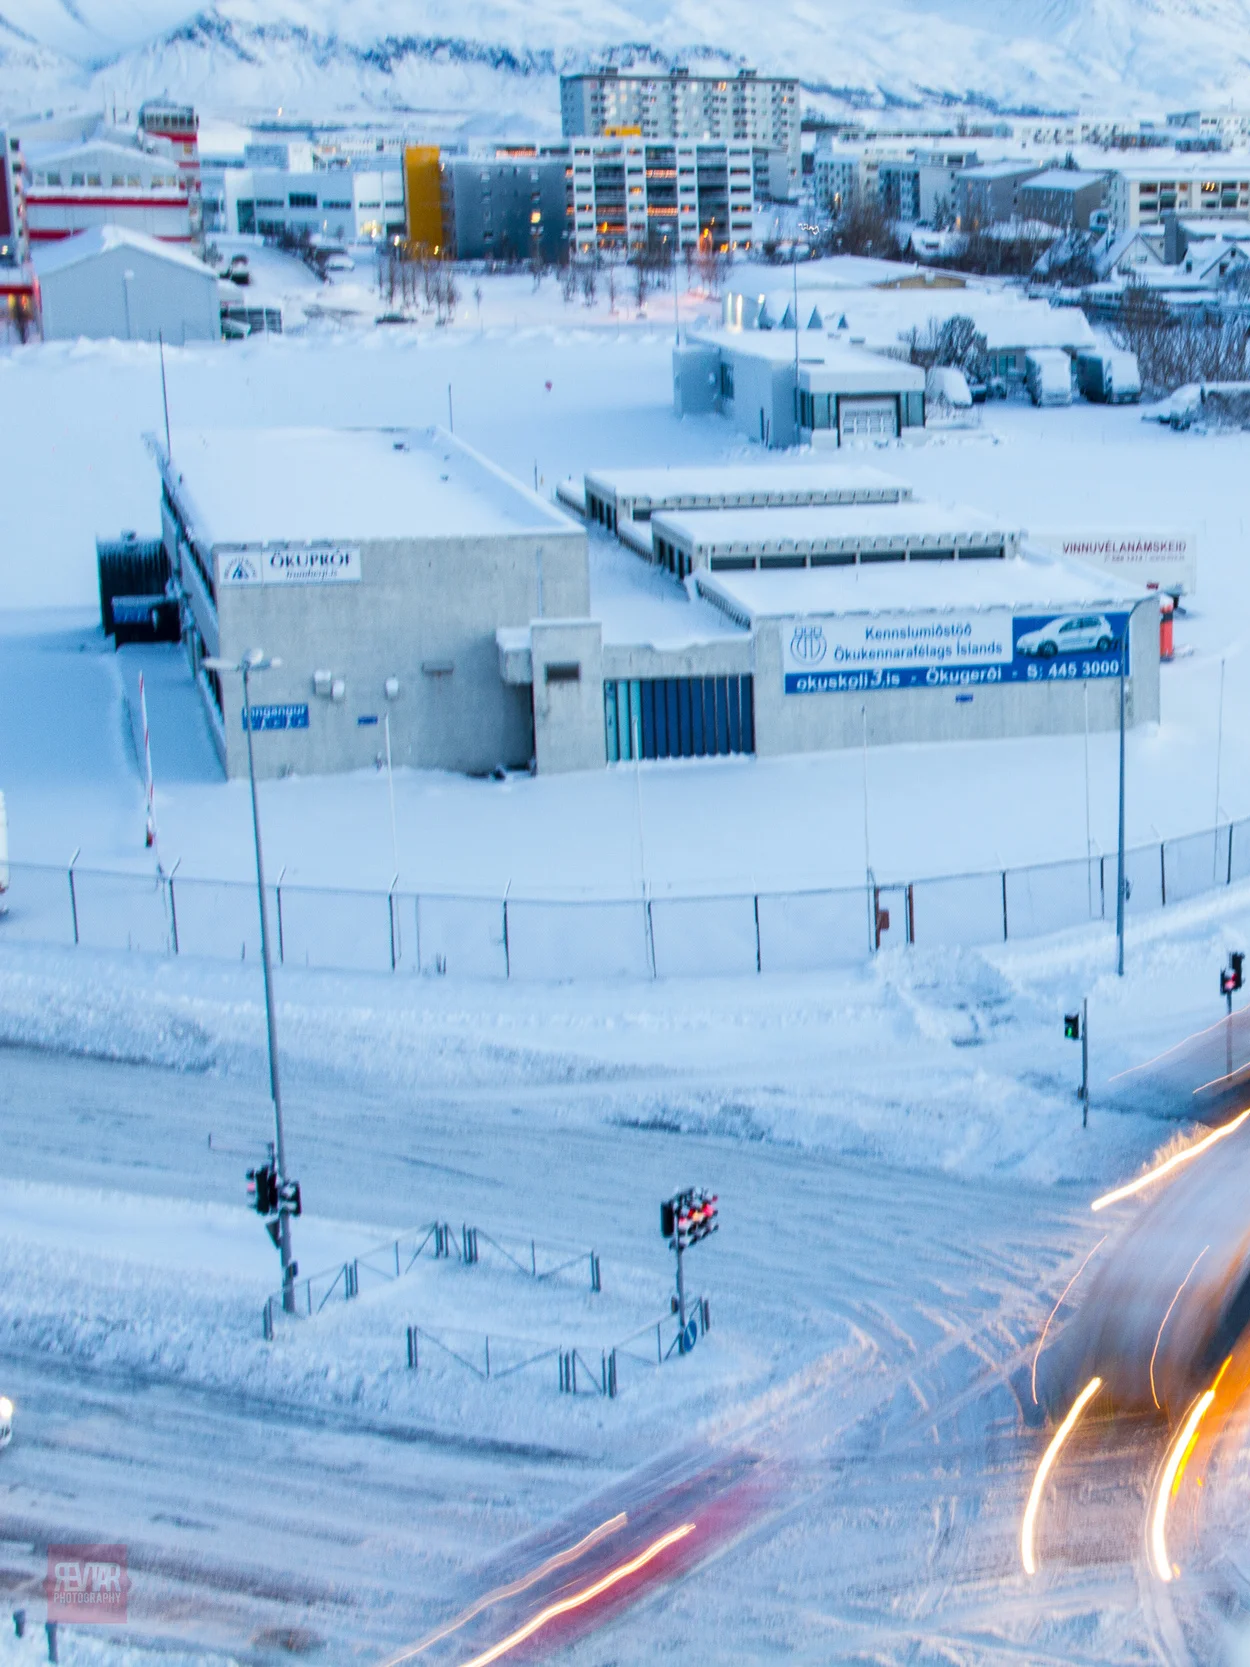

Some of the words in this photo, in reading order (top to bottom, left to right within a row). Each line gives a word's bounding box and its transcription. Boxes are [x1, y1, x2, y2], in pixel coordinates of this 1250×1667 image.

[834, 642, 952, 661] Ökukennarafélags
[956, 638, 1002, 655] Íslands
[1048, 661, 1077, 678] 445
[1082, 658, 1119, 676] 3000
